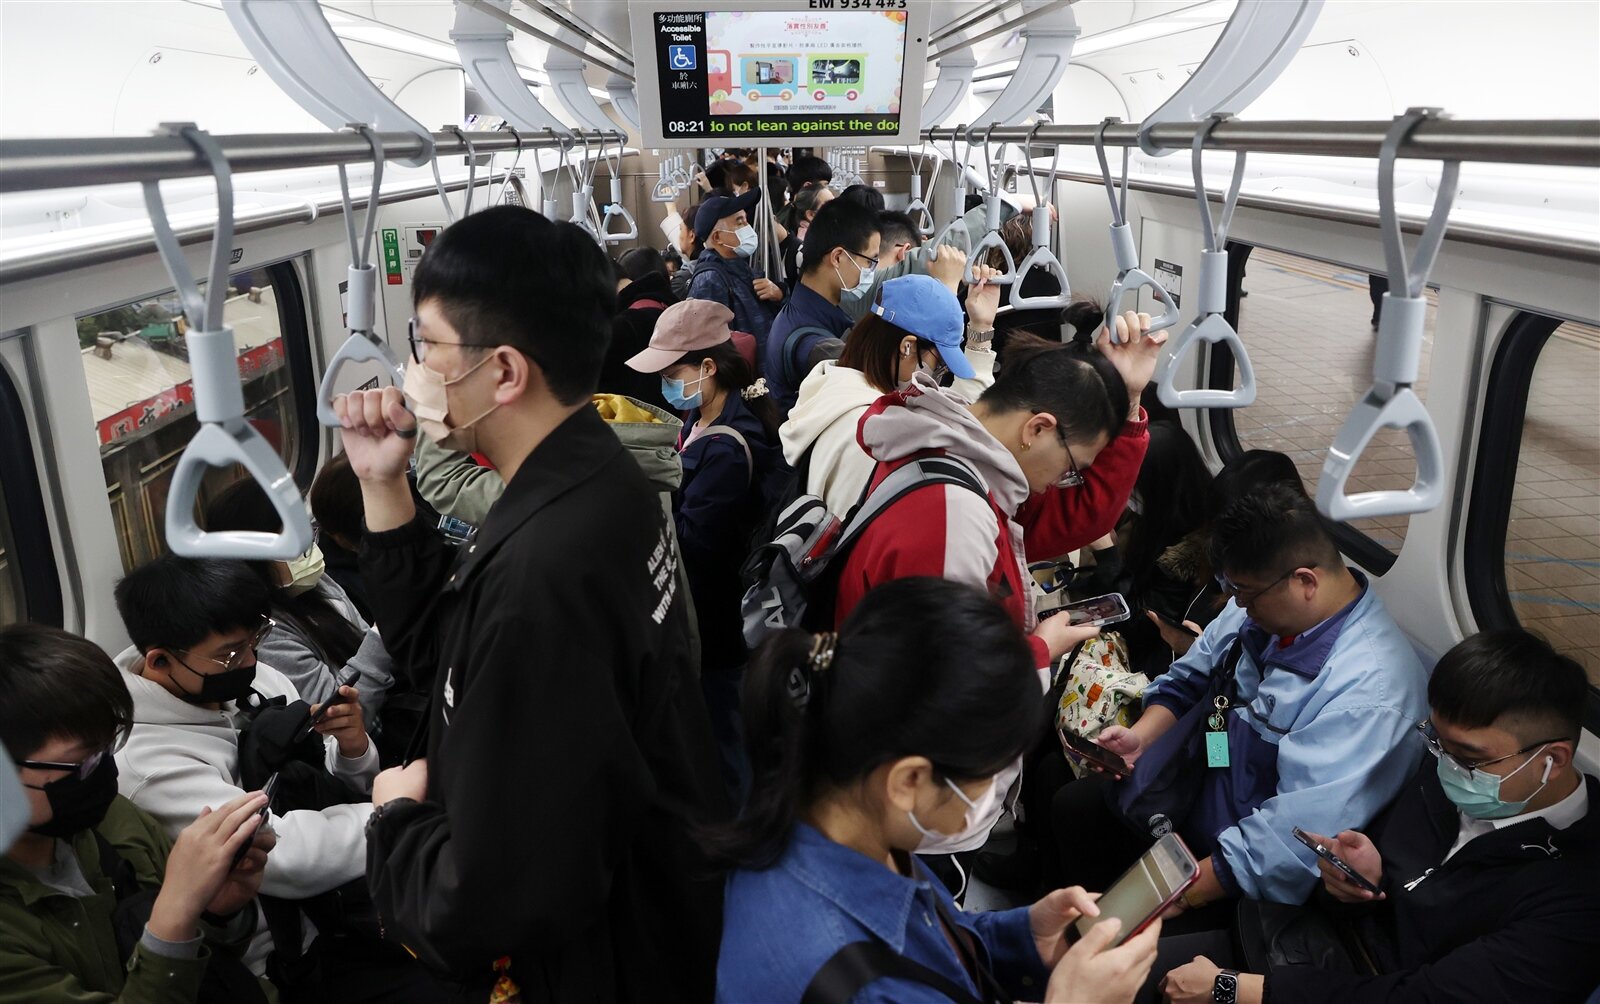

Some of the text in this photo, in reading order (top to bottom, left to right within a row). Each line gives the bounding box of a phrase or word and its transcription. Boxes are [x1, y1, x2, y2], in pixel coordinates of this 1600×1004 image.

[809, 0, 834, 8] EM
[669, 121, 704, 132] 08:21
[729, 120, 753, 131] not
[757, 120, 787, 131] lean
[792, 119, 845, 133] against
[849, 119, 872, 130] the
